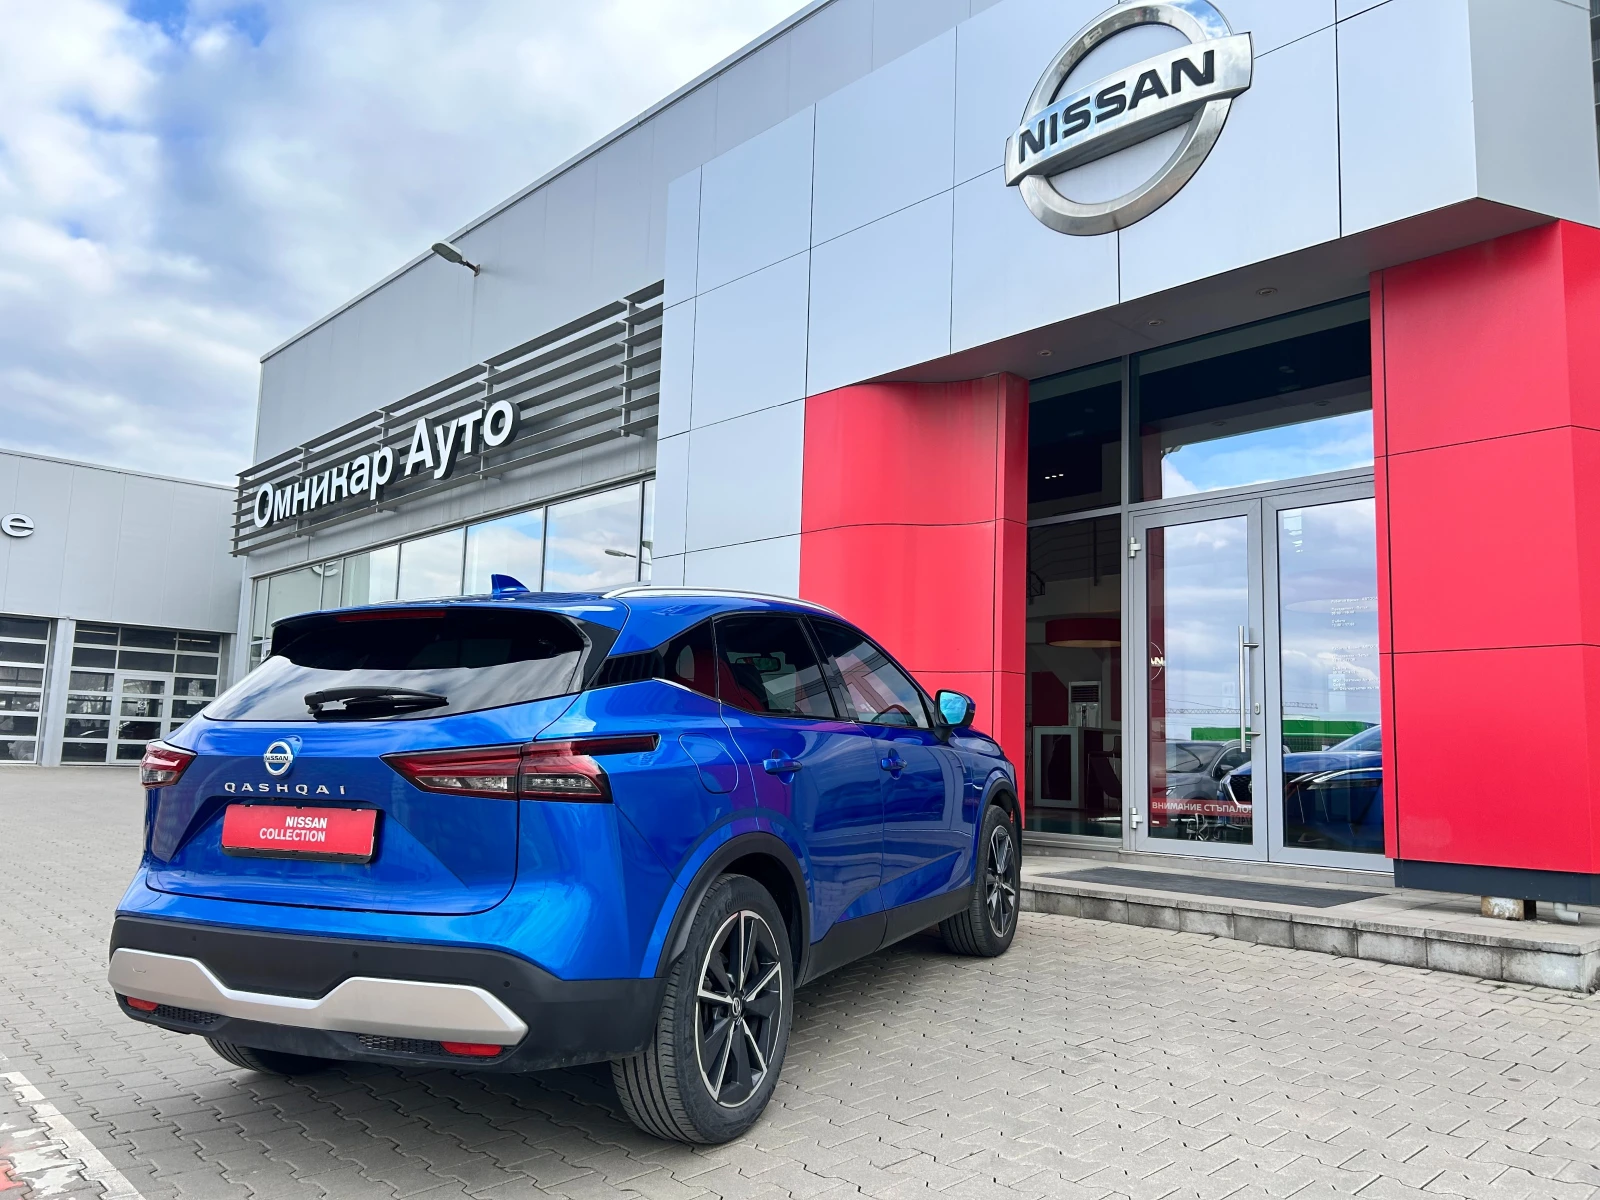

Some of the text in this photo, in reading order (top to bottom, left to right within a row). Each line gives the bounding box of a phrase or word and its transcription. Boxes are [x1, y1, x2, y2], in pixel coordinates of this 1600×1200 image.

[1018, 49, 1215, 164] NISSAN
[253, 400, 515, 528] Омникар Ауто
[224, 782, 346, 796] QASHQAI
[1152, 802, 1202, 811] ВНИМАНИЕ
[285, 816, 328, 829] NISSAN
[259, 828, 326, 842] COLLECTION
